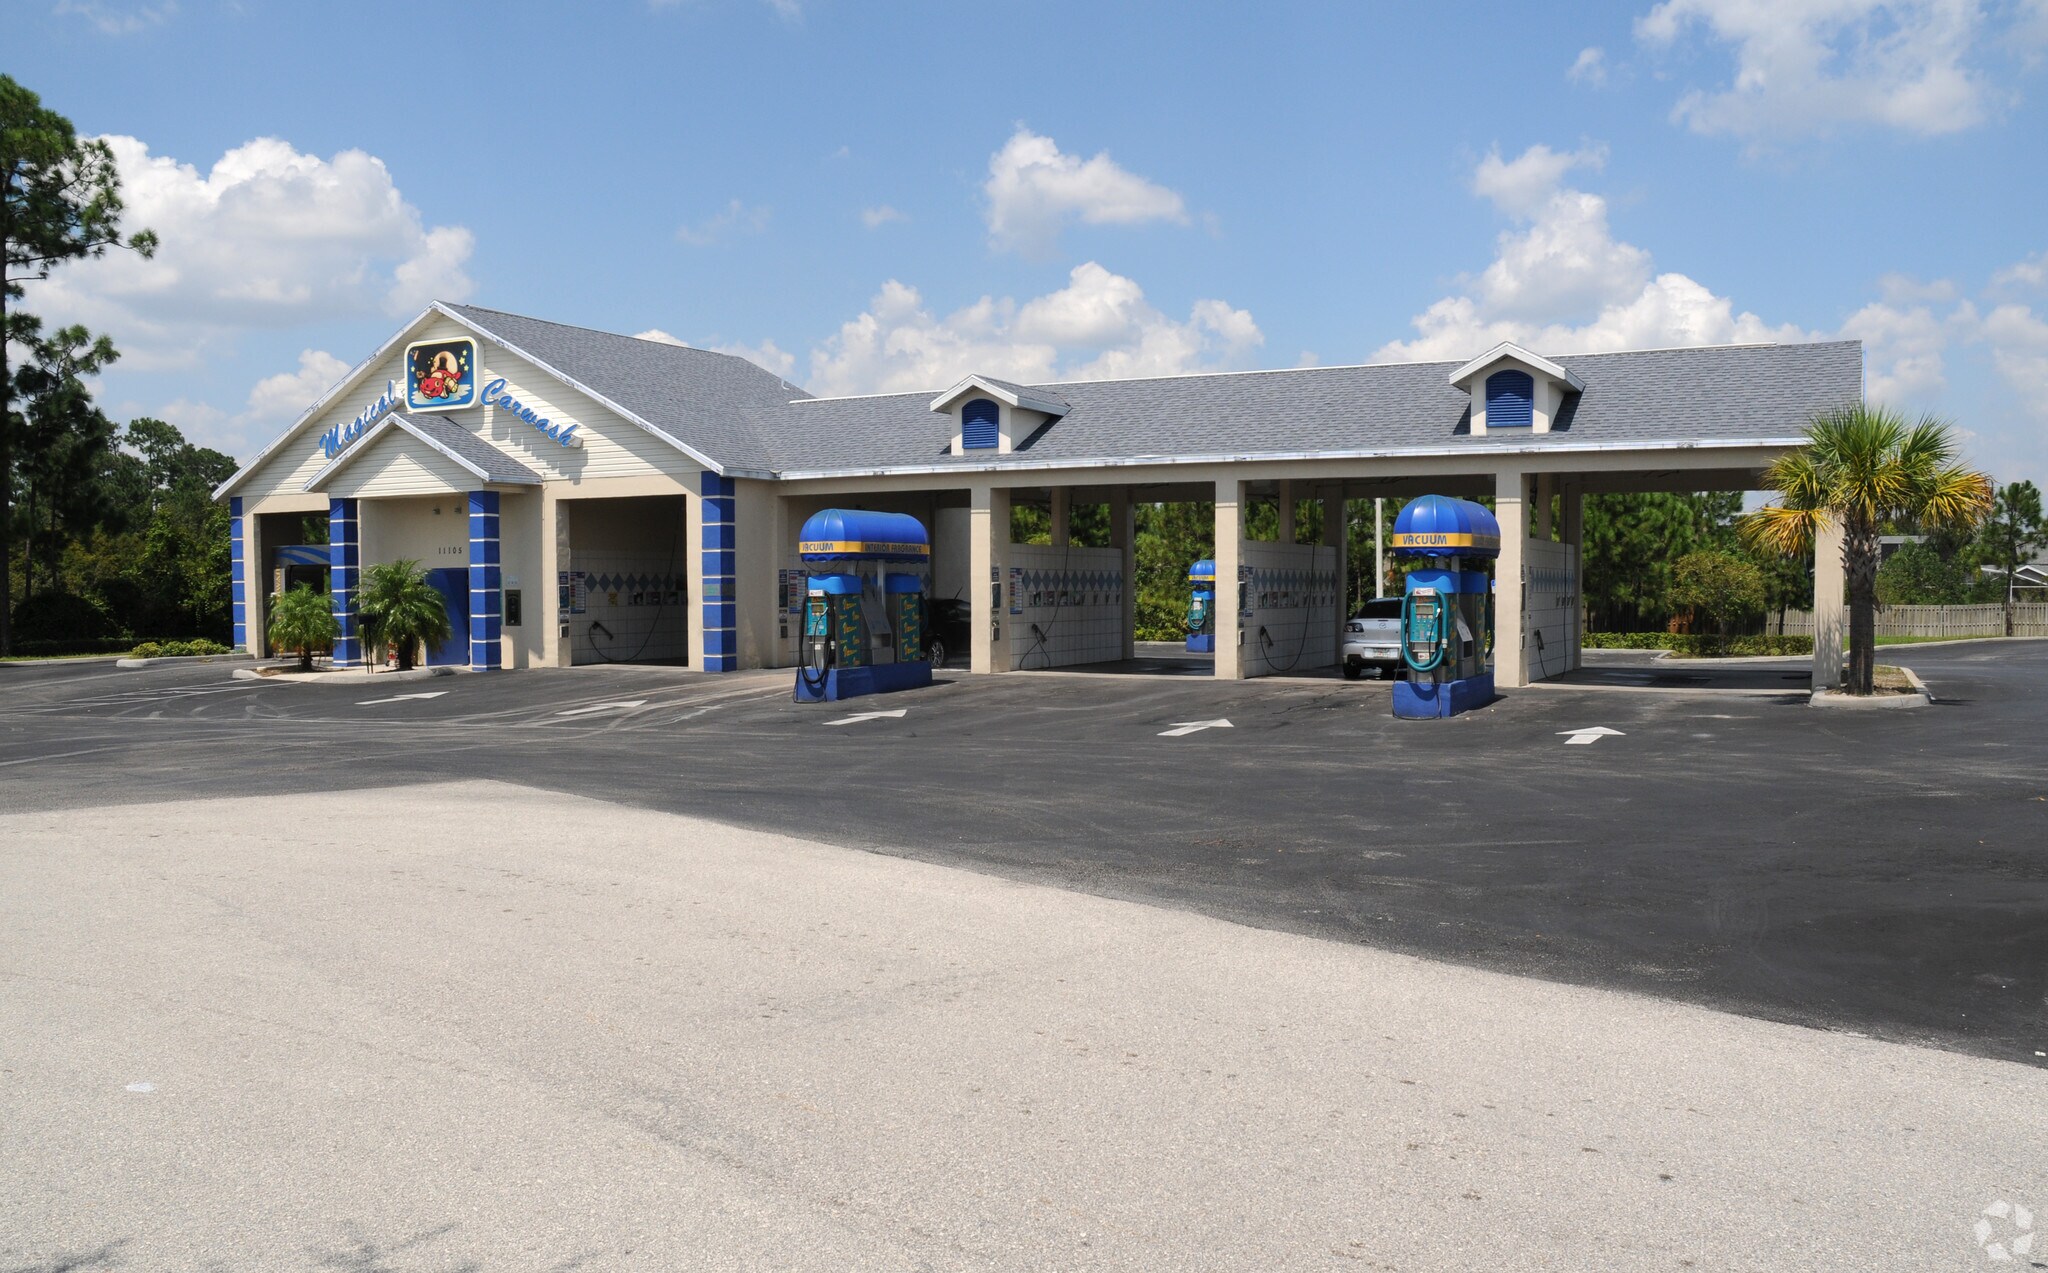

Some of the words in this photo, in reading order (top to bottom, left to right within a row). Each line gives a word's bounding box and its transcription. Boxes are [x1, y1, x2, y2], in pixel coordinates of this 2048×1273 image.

[319, 379, 395, 459] Magical
[481, 378, 578, 447] Carwash
[1402, 534, 1447, 545] VACUUM
[438, 546, 462, 554] 11105
